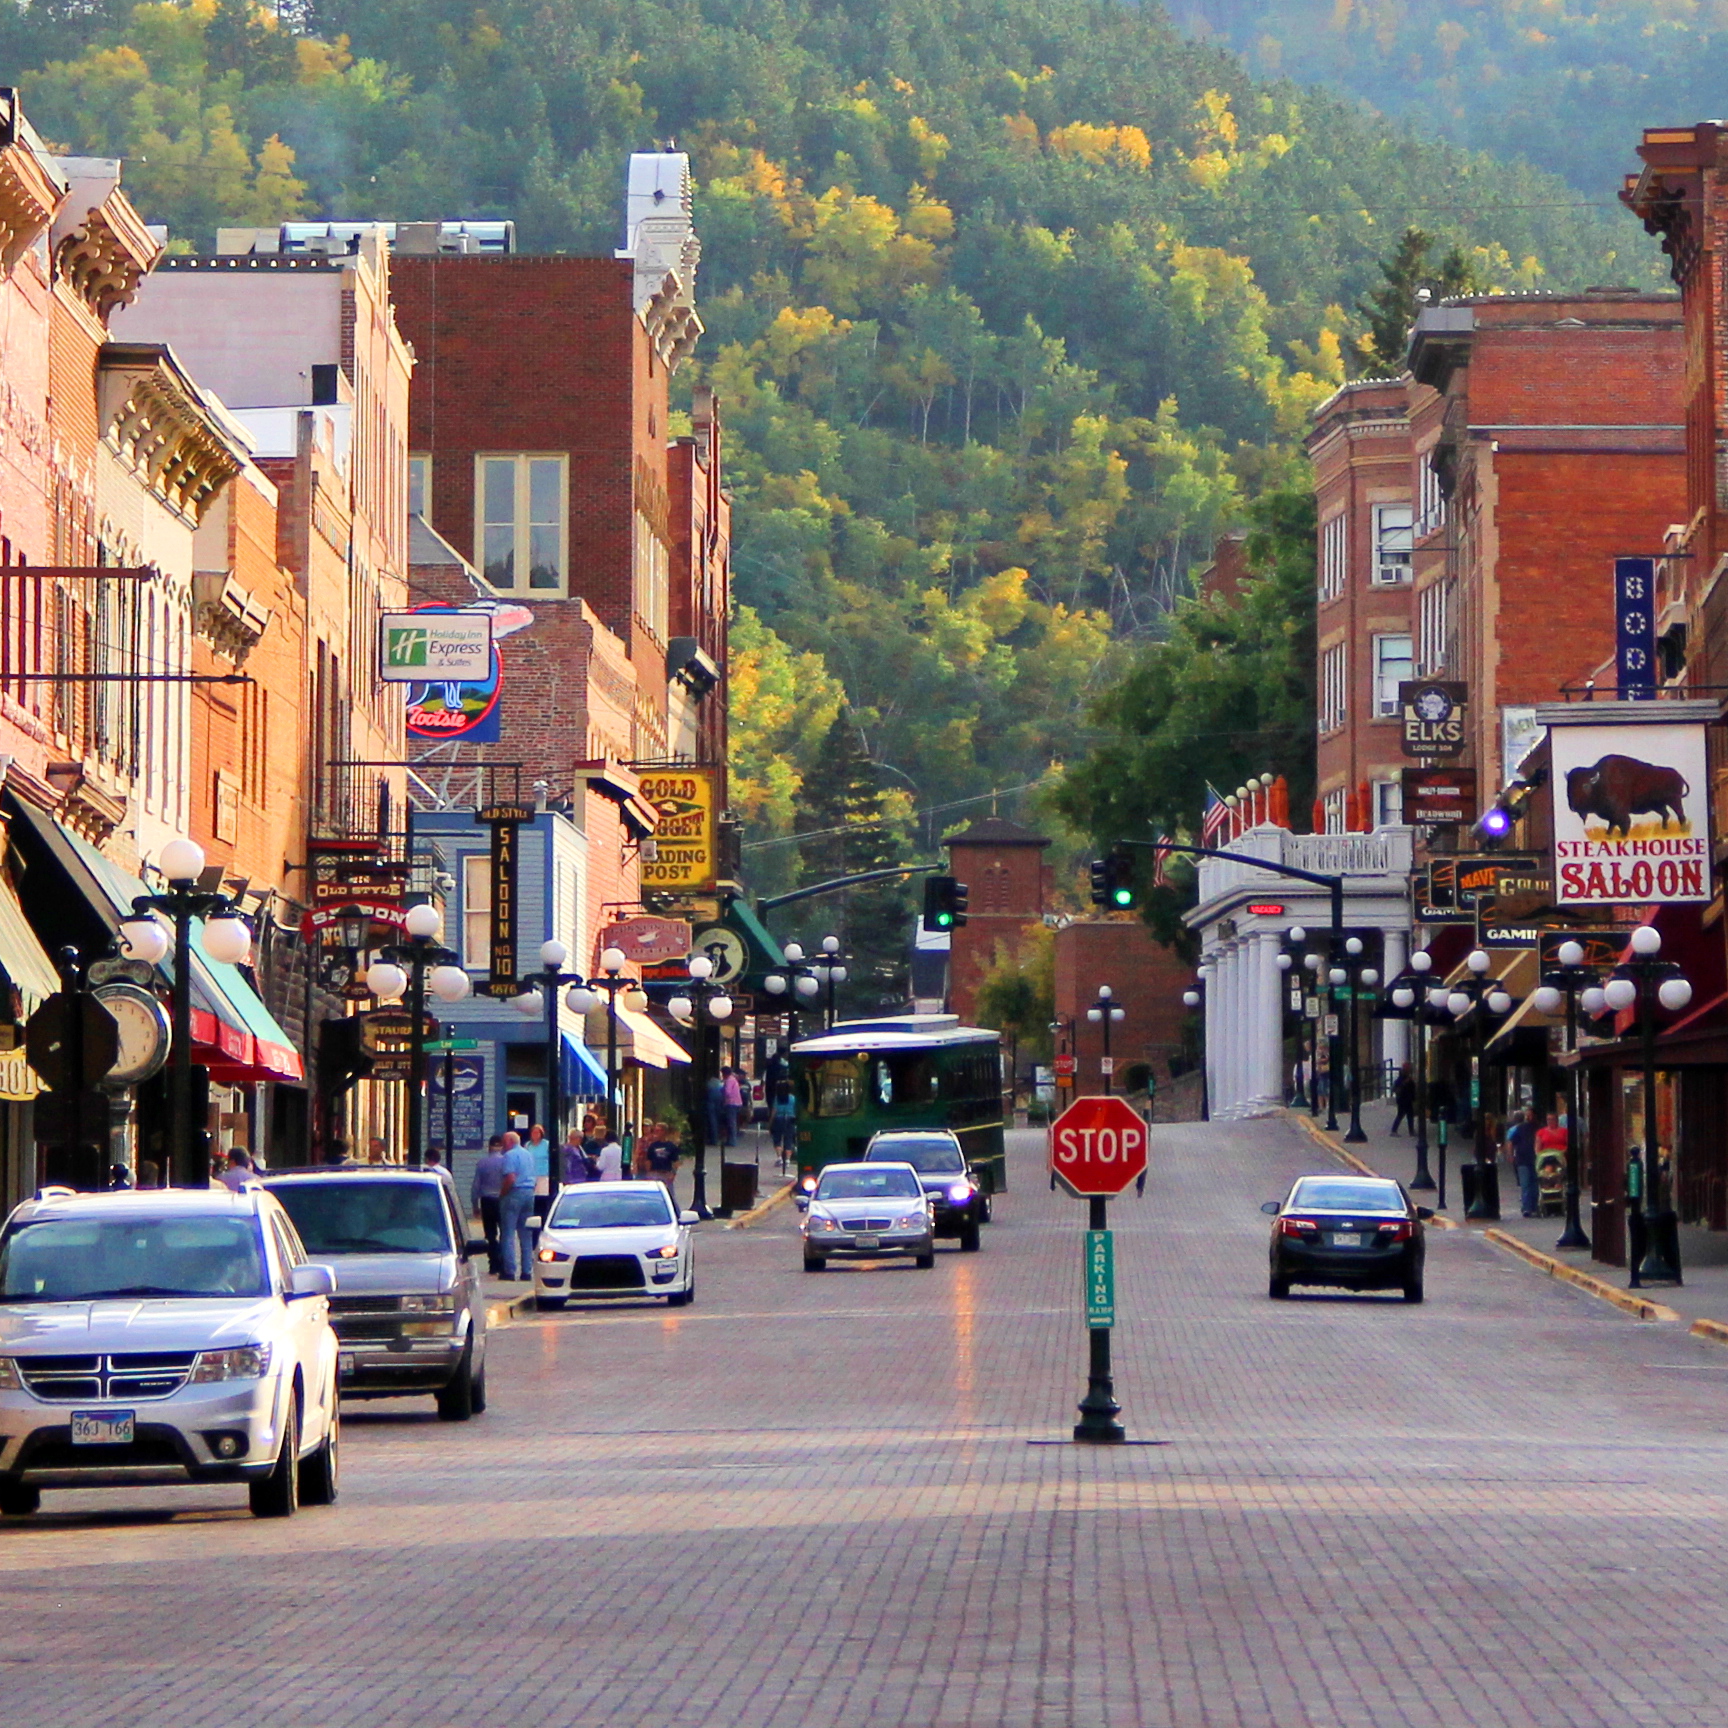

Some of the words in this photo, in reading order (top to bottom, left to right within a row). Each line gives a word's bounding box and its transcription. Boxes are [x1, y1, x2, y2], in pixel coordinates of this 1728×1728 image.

[430, 629, 466, 640] Holiday
[468, 631, 483, 639] Inn
[429, 640, 483, 657] Express
[447, 658, 472, 667] Suites
[408, 705, 467, 728] Tootsie
[1405, 721, 1461, 742] ELKS
[640, 778, 697, 801] GOLD
[656, 812, 705, 837] GGET
[655, 849, 707, 864] ADING
[1557, 838, 1706, 858] STEAKHOUSE
[643, 865, 692, 880] POST
[1561, 859, 1706, 900] SALOON
[316, 884, 348, 898] OLD
[351, 883, 401, 898] STYLE
[1486, 929, 1537, 940] GAMI
[495, 958, 512, 976] 10
[1058, 1128, 1141, 1163] STOP
[1093, 1233, 1107, 1304] PARKING
[74, 1421, 100, 1437] 36J
[108, 1420, 131, 1436] 166
